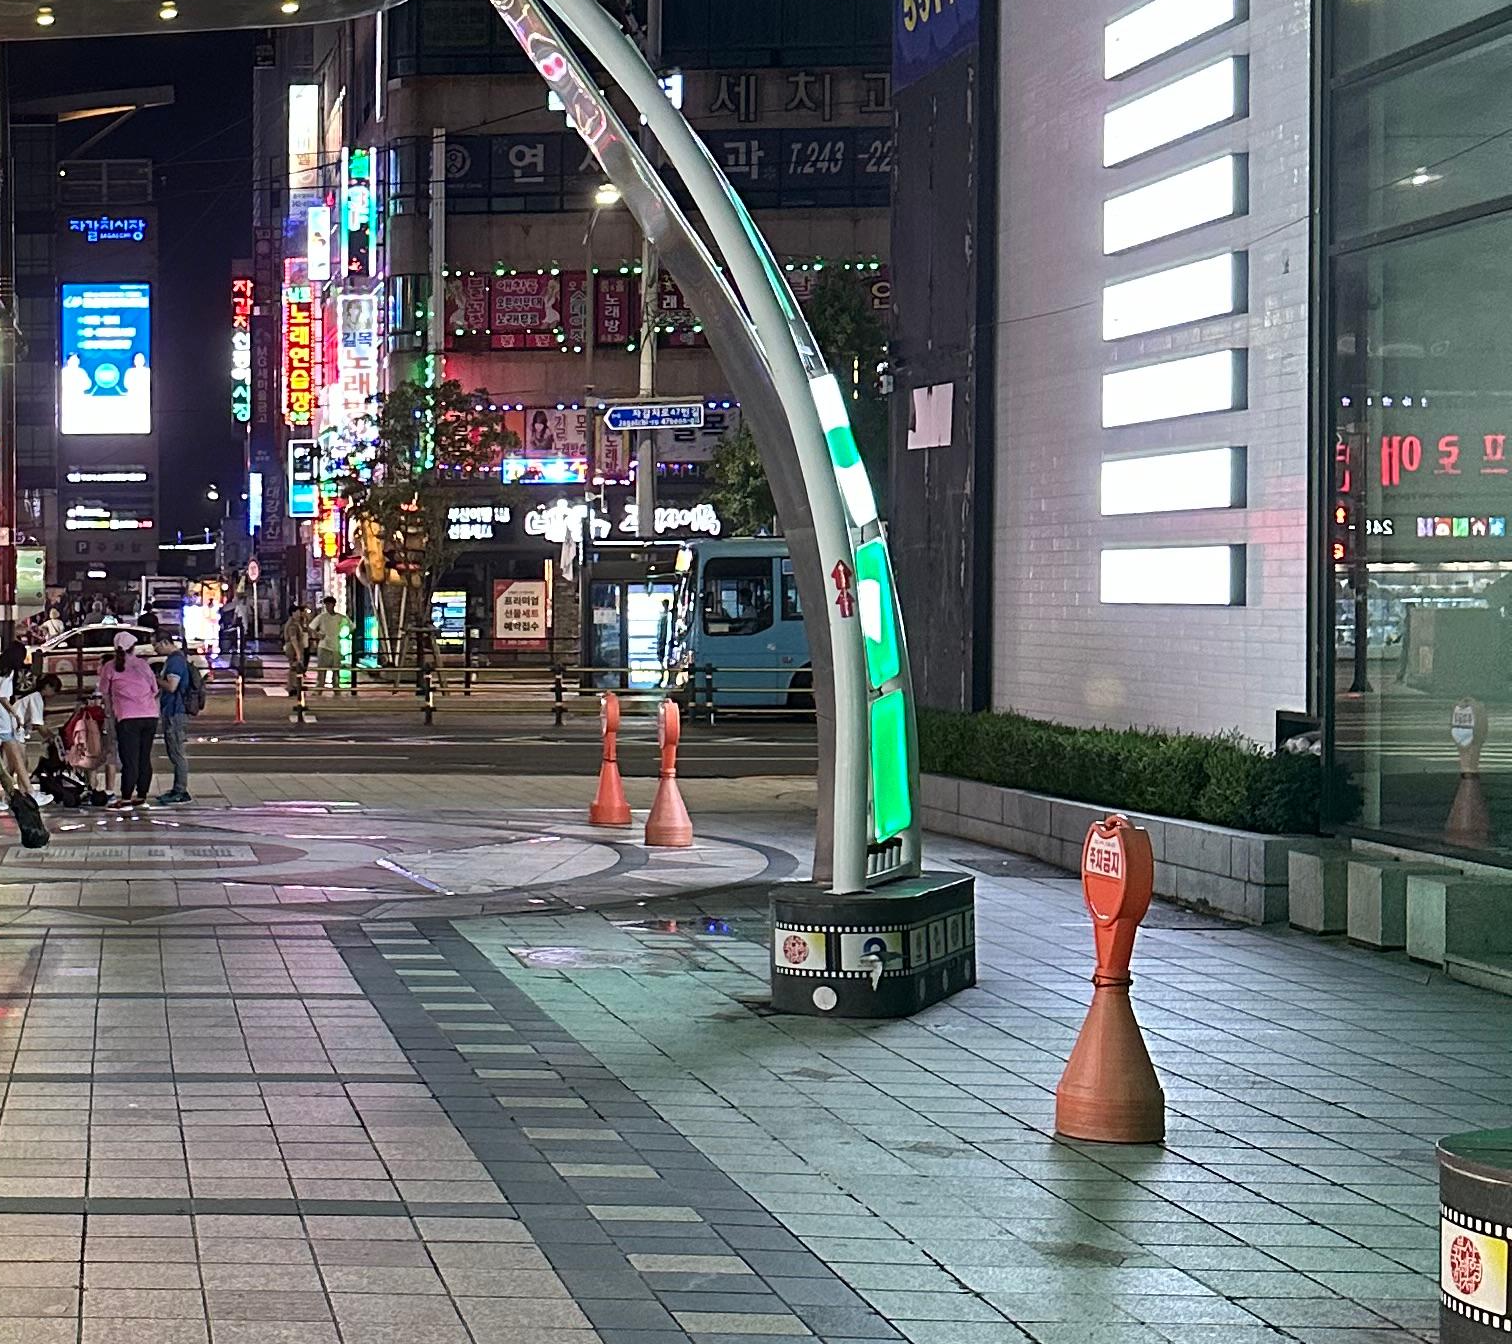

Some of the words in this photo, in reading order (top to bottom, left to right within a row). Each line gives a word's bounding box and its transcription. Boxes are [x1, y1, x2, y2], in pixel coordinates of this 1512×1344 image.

[603, 293, 621, 333] 노래방
[342, 331, 373, 348] 길목
[1089, 845, 1121, 876] 주차금지
